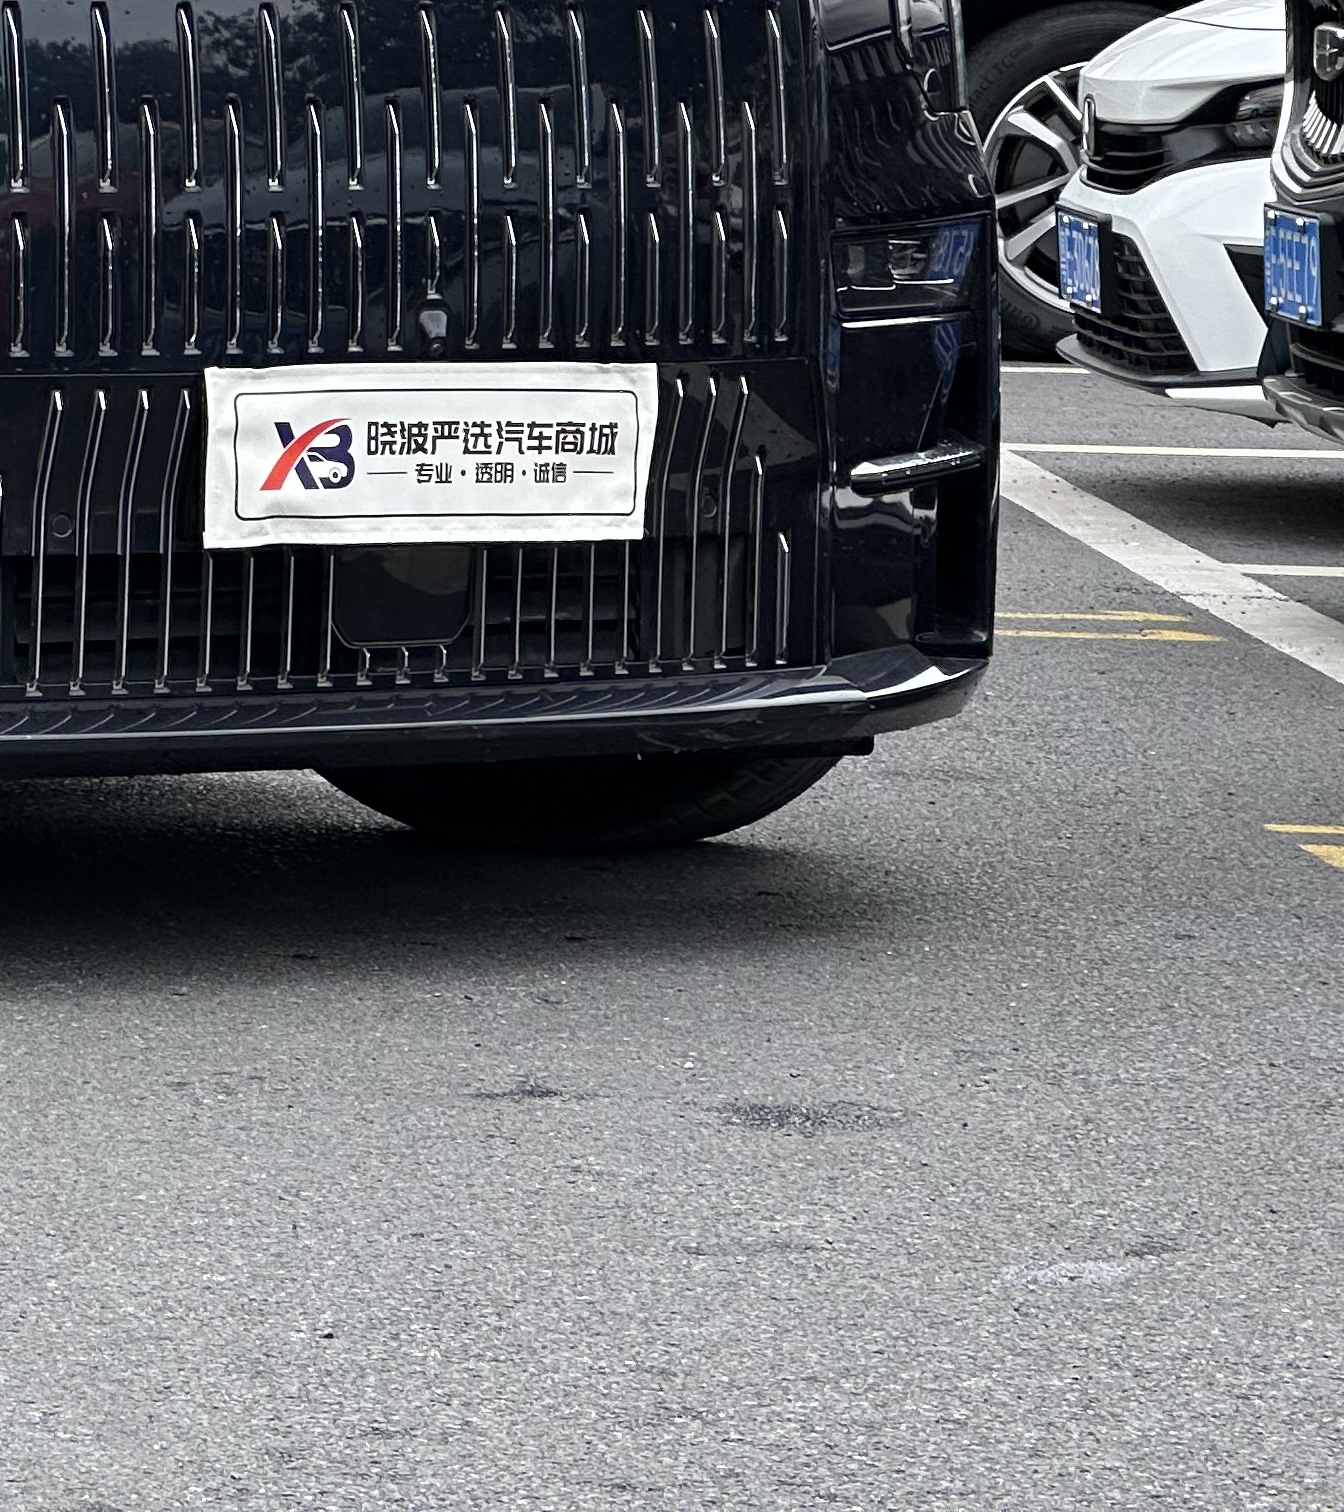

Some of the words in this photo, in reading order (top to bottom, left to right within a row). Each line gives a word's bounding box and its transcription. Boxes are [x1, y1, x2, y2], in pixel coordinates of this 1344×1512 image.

[366, 420, 618, 457] 晓波严选汽车商城
